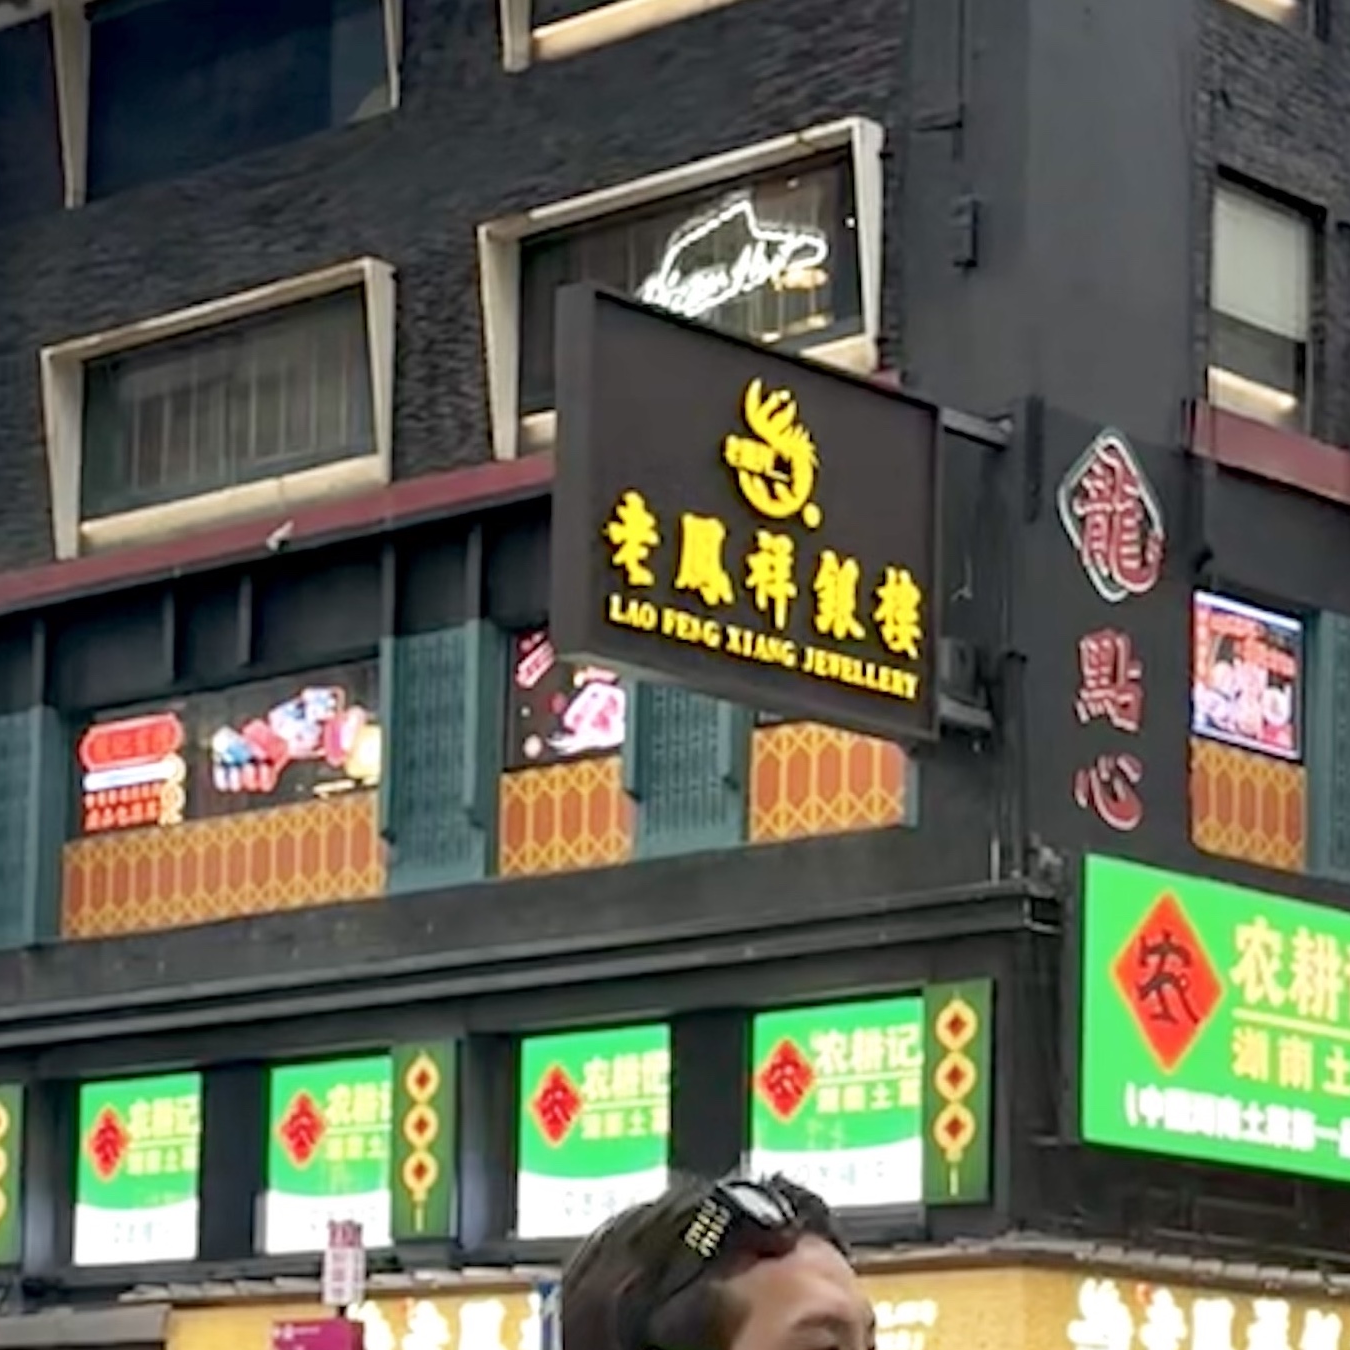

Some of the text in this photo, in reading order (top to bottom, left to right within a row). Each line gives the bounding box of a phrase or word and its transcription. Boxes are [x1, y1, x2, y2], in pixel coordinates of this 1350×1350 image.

[605, 490, 923, 659] 老鳳祥銀樓
[608, 592, 919, 702] LAO FENG XIANG JEWELLERY
